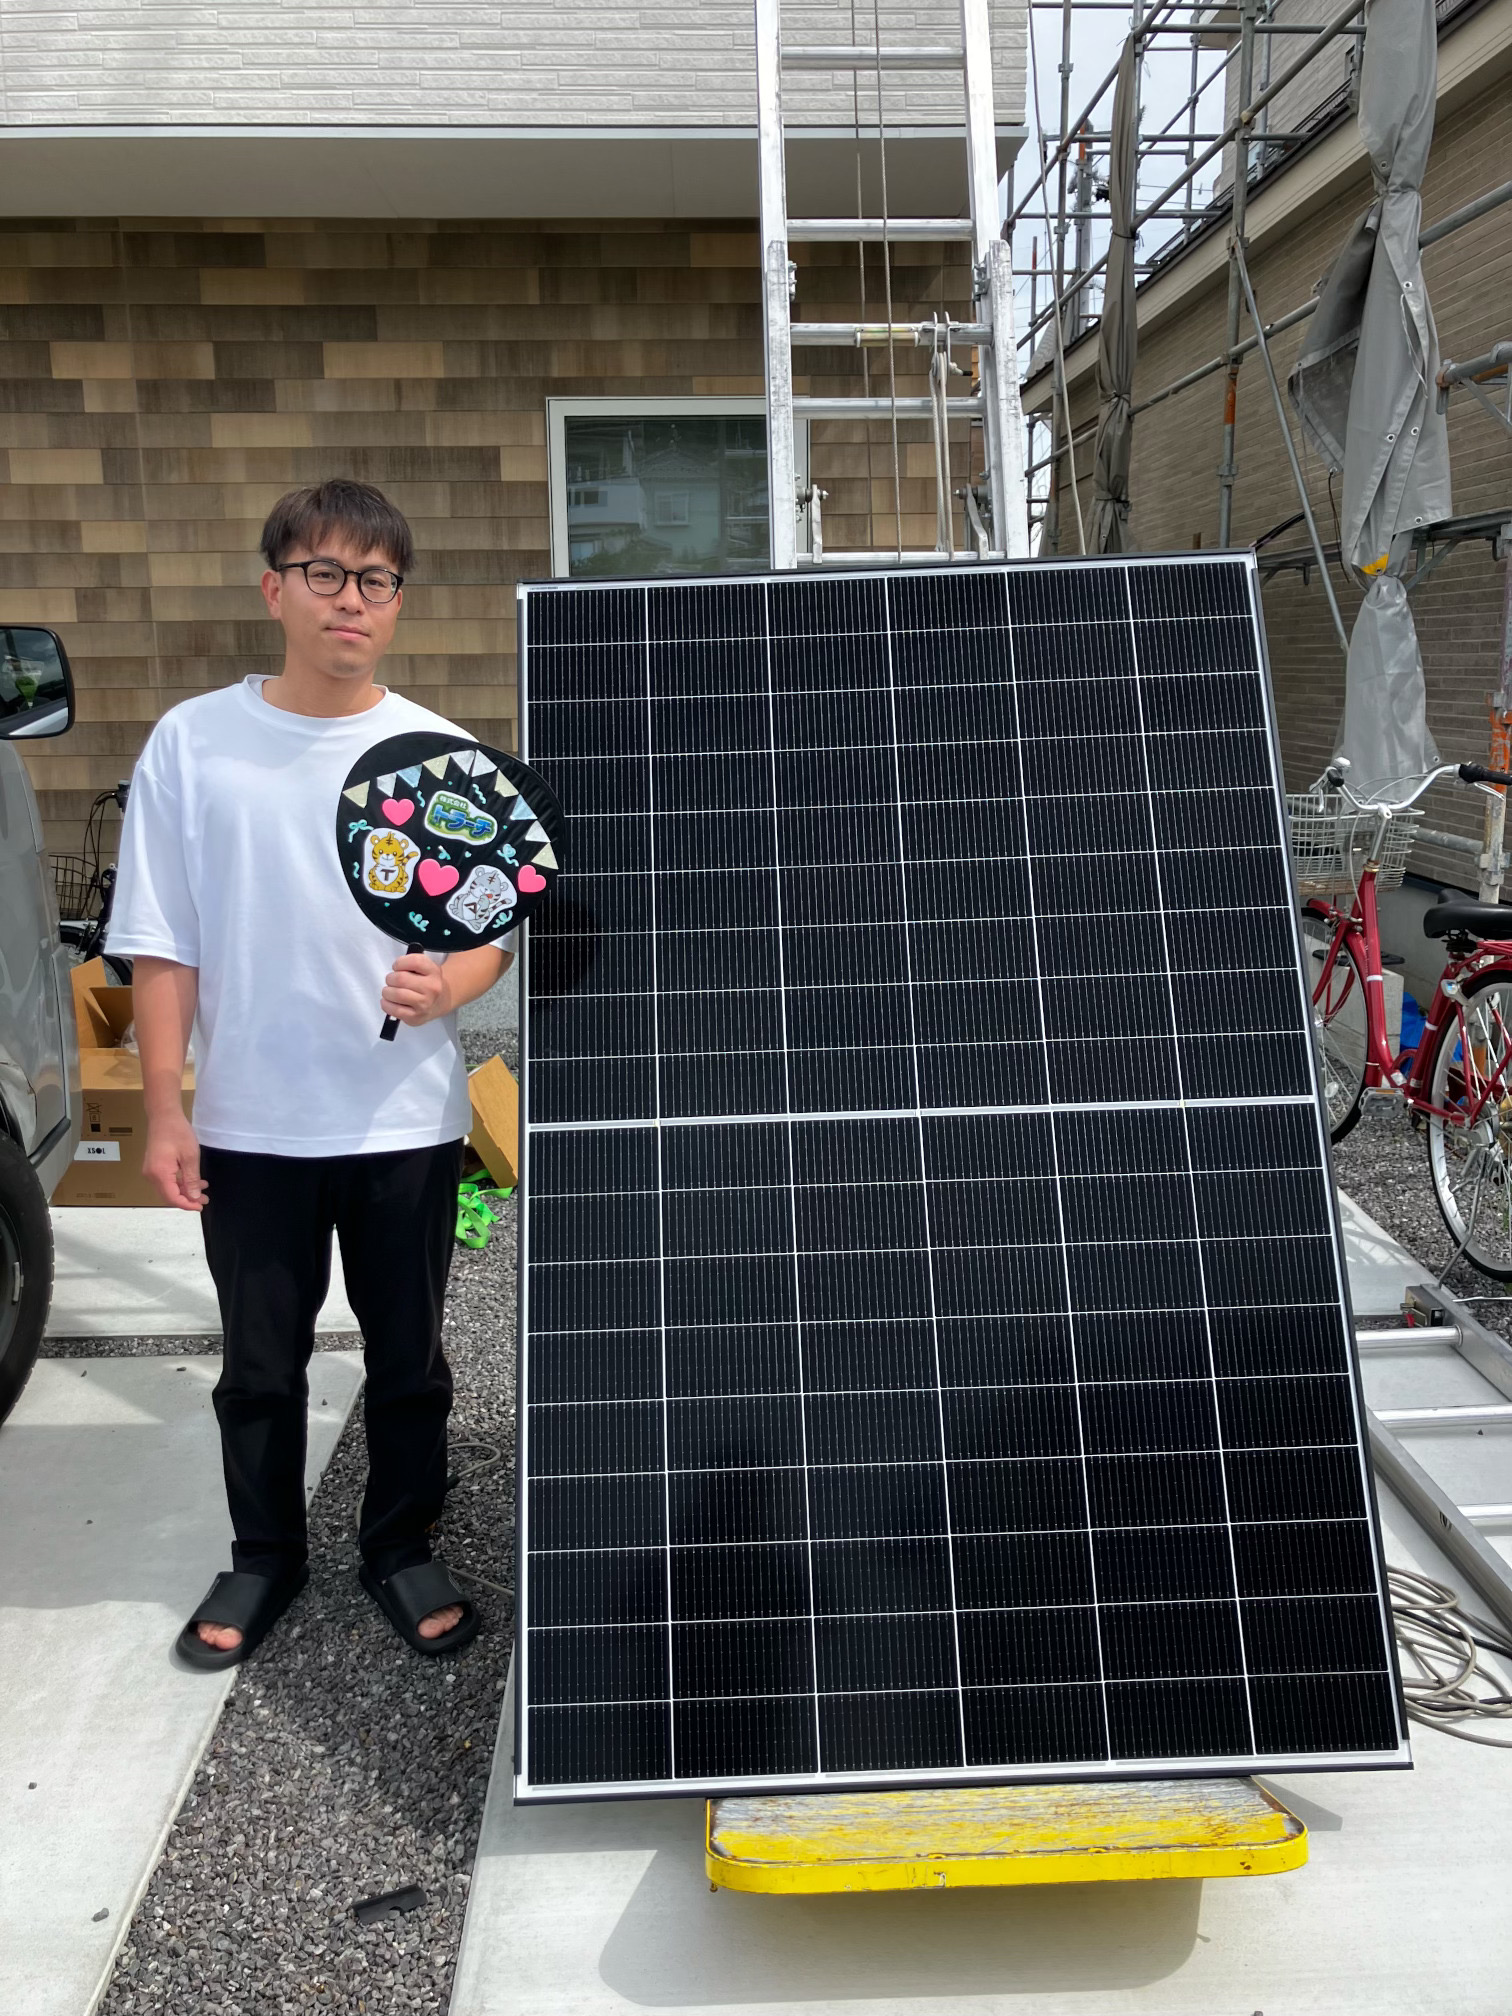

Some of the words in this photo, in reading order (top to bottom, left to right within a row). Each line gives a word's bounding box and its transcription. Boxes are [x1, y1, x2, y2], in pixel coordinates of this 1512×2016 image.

[439, 795, 468, 810] 株式会社
[433, 804, 492, 836] トラーチ
[380, 868, 397, 882] T
[87, 1147, 106, 1155] XSOL
